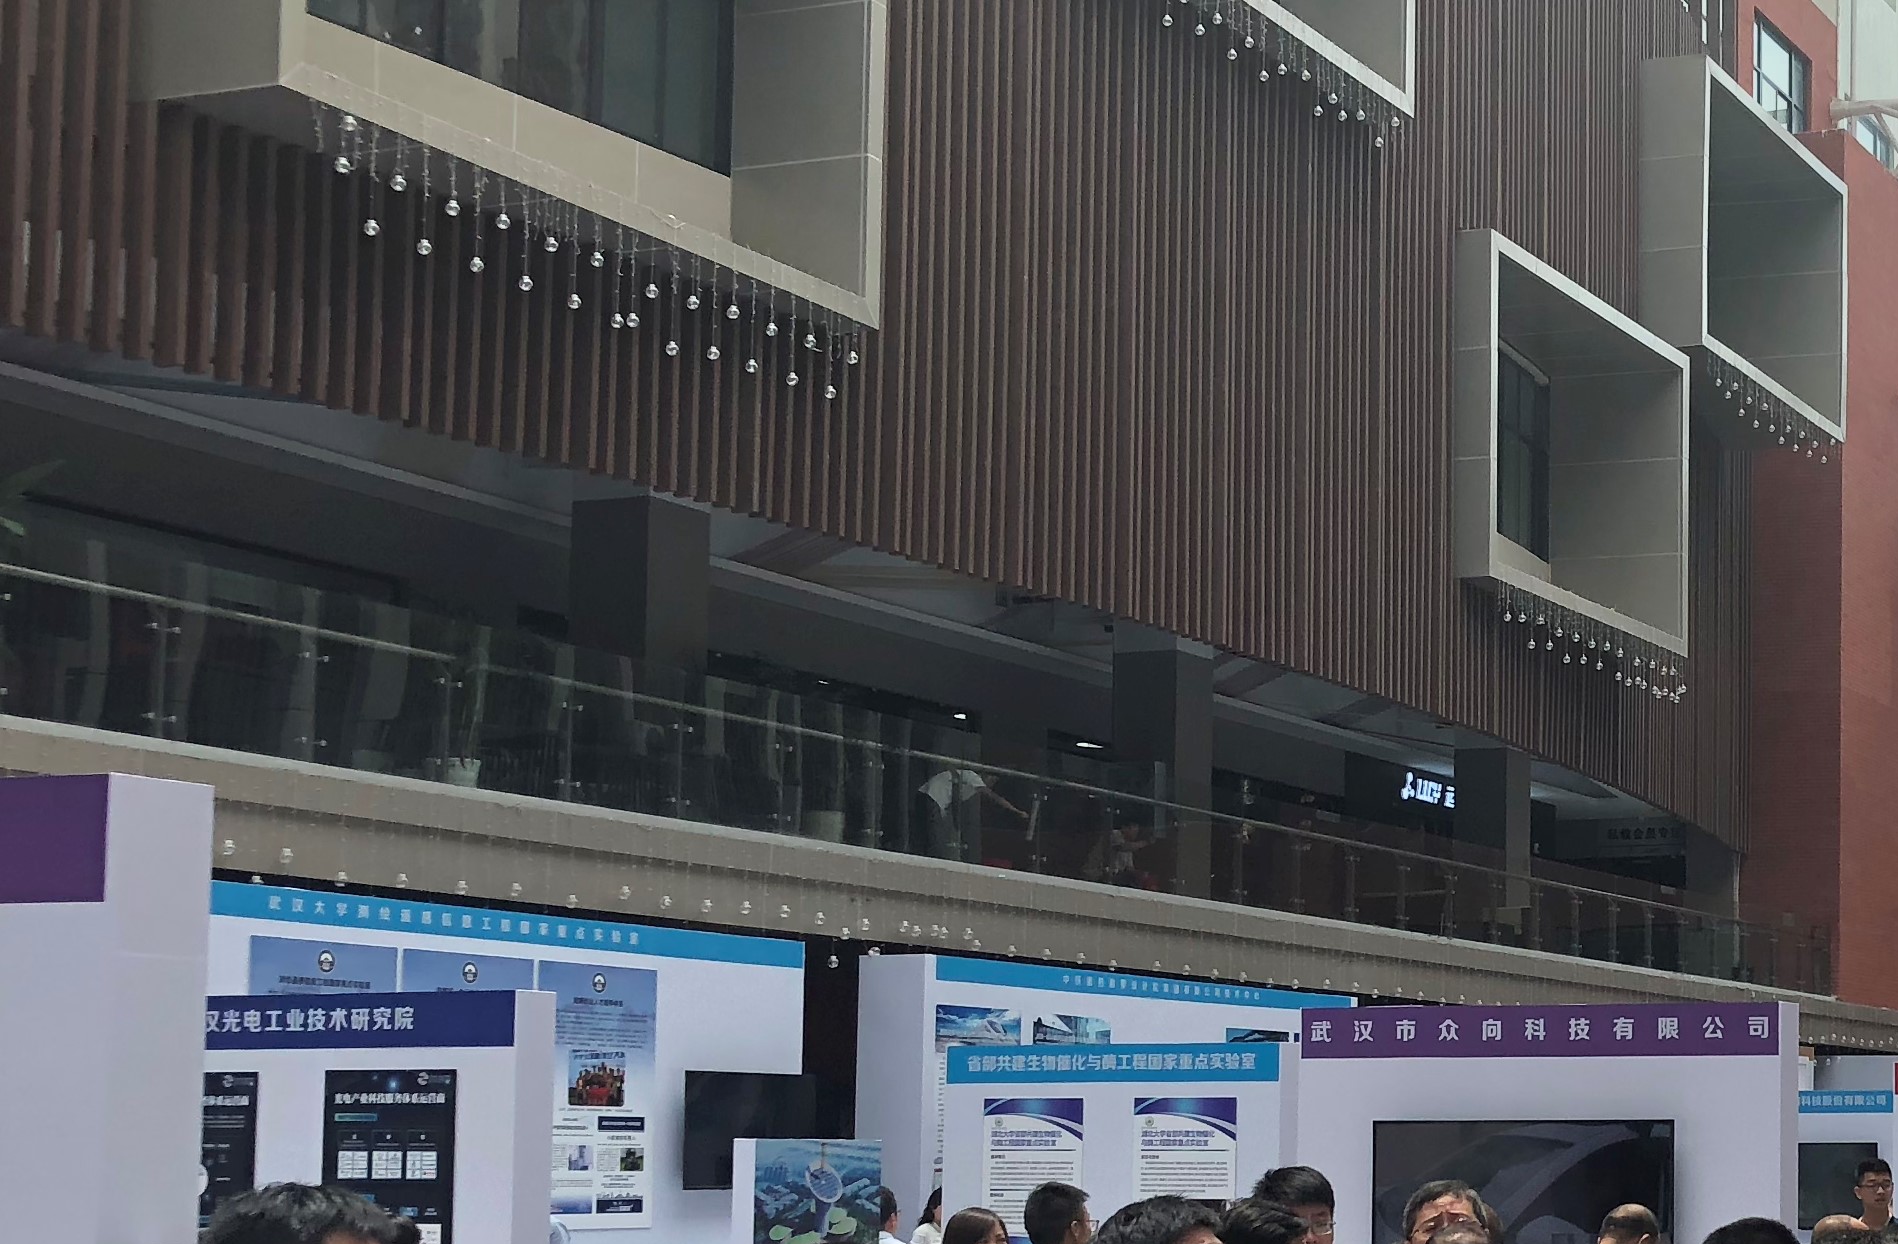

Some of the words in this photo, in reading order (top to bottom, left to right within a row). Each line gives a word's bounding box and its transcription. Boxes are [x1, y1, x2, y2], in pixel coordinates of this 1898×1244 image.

[1310, 1015, 1770, 1043] 武汉市众向科技有限公司
[968, 1053, 1256, 1072] 省部共建生物催化与酶工程国家重点实验室
[1799, 1093, 1888, 1107] 科技股份有限公司
